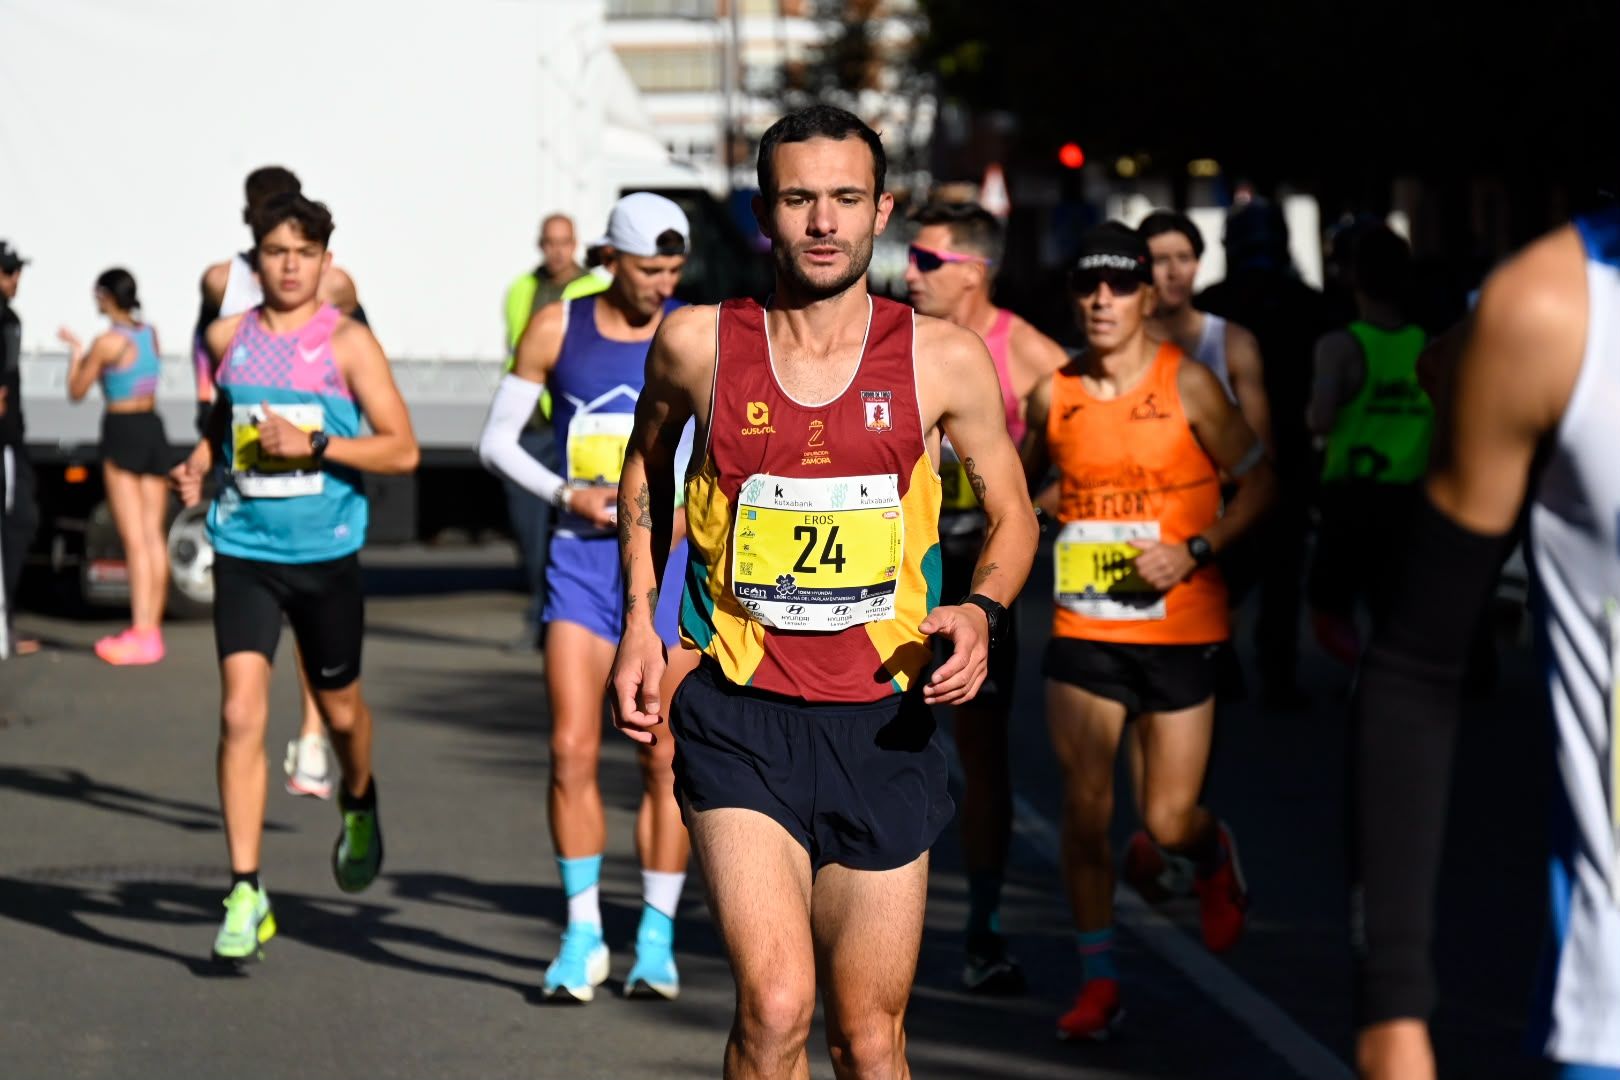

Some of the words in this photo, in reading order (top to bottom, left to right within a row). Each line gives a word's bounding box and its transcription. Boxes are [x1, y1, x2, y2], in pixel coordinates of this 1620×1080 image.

[741, 426, 776, 435] austral
[801, 457, 831, 465] ZAMORA
[775, 484, 783, 498] k
[861, 484, 868, 497] k
[774, 498, 813, 507] kutxabank
[860, 497, 894, 505] kutxabank
[804, 515, 834, 525] EROS
[793, 525, 846, 573] 24
